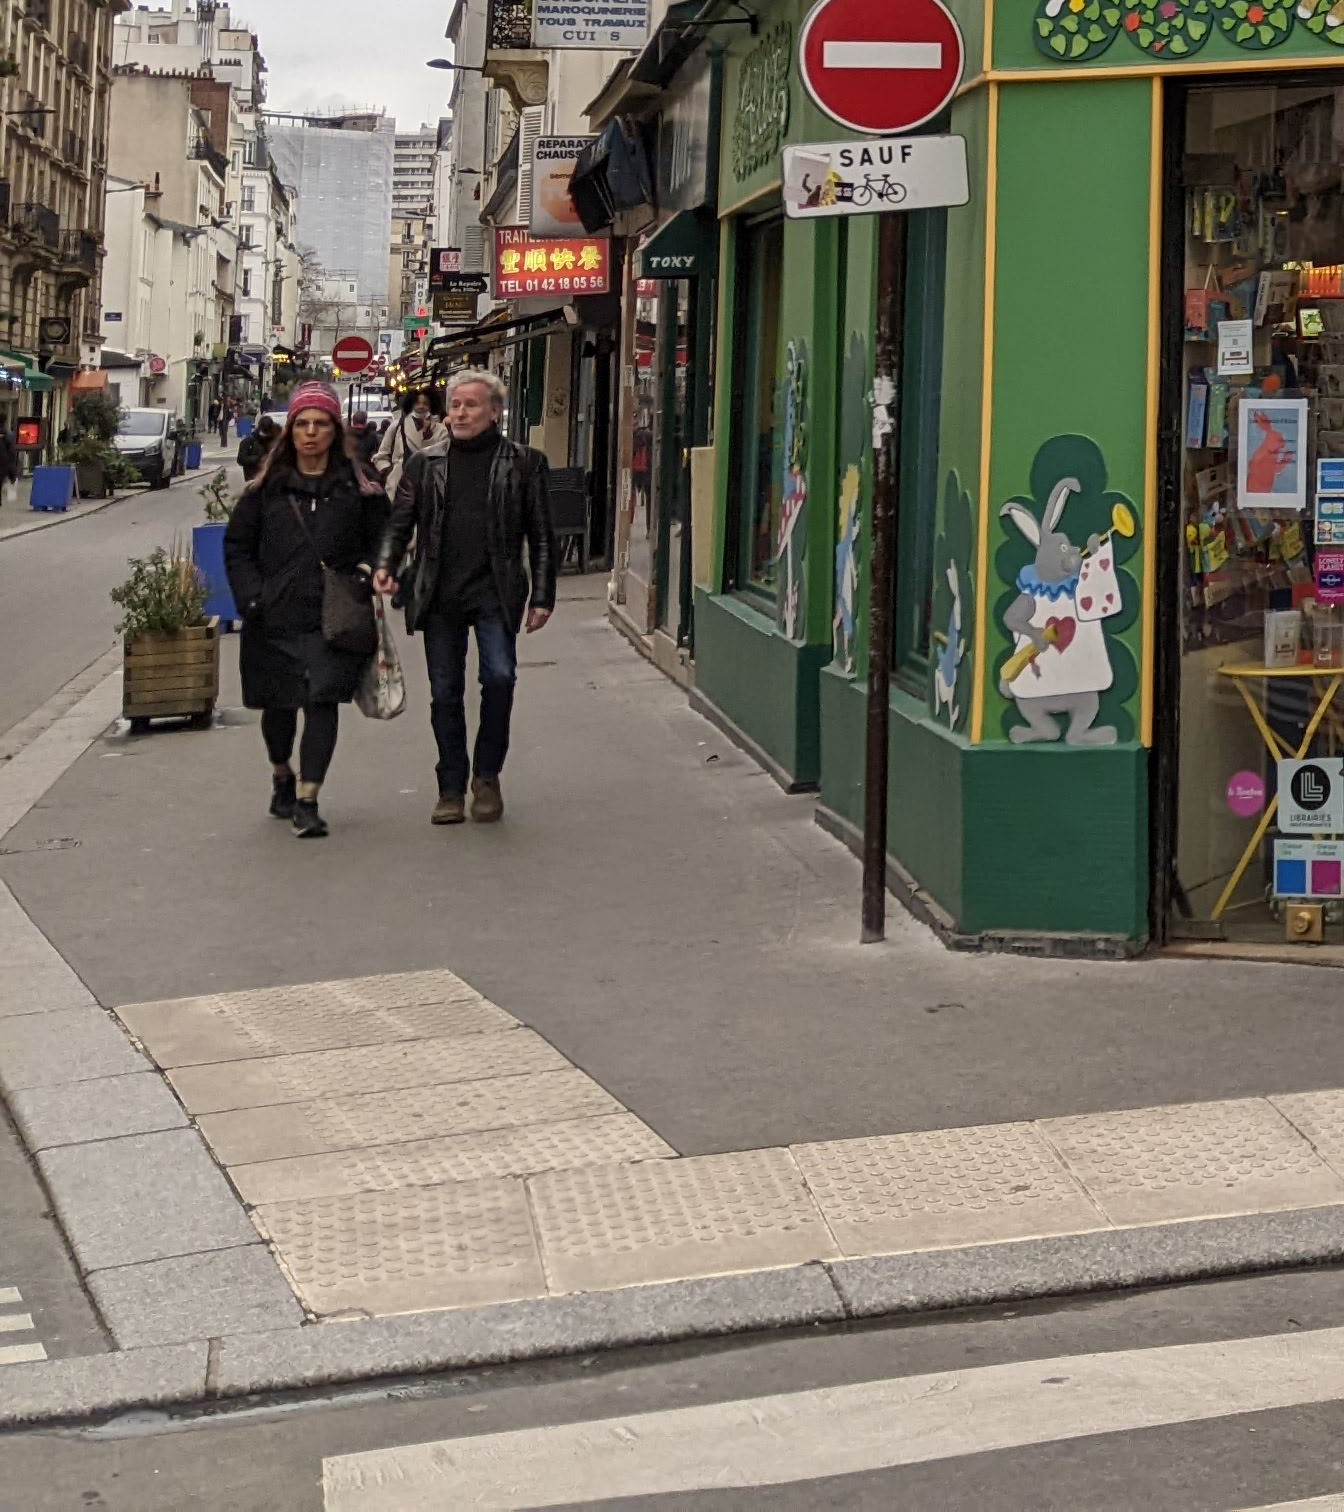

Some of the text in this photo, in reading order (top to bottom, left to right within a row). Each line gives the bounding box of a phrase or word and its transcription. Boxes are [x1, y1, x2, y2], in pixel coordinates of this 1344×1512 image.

[537, 5, 647, 16] MAROQUINERIE
[537, 17, 646, 28] TOUS TRAVAUX
[840, 145, 912, 167] SAUF
[500, 280, 523, 293] TEL
[526, 278, 538, 291] 01
[541, 278, 555, 290] 42
[558, 277, 570, 289] 18
[573, 276, 586, 289] 05
[1290, 815, 1331, 823] LIBRAIRIES
